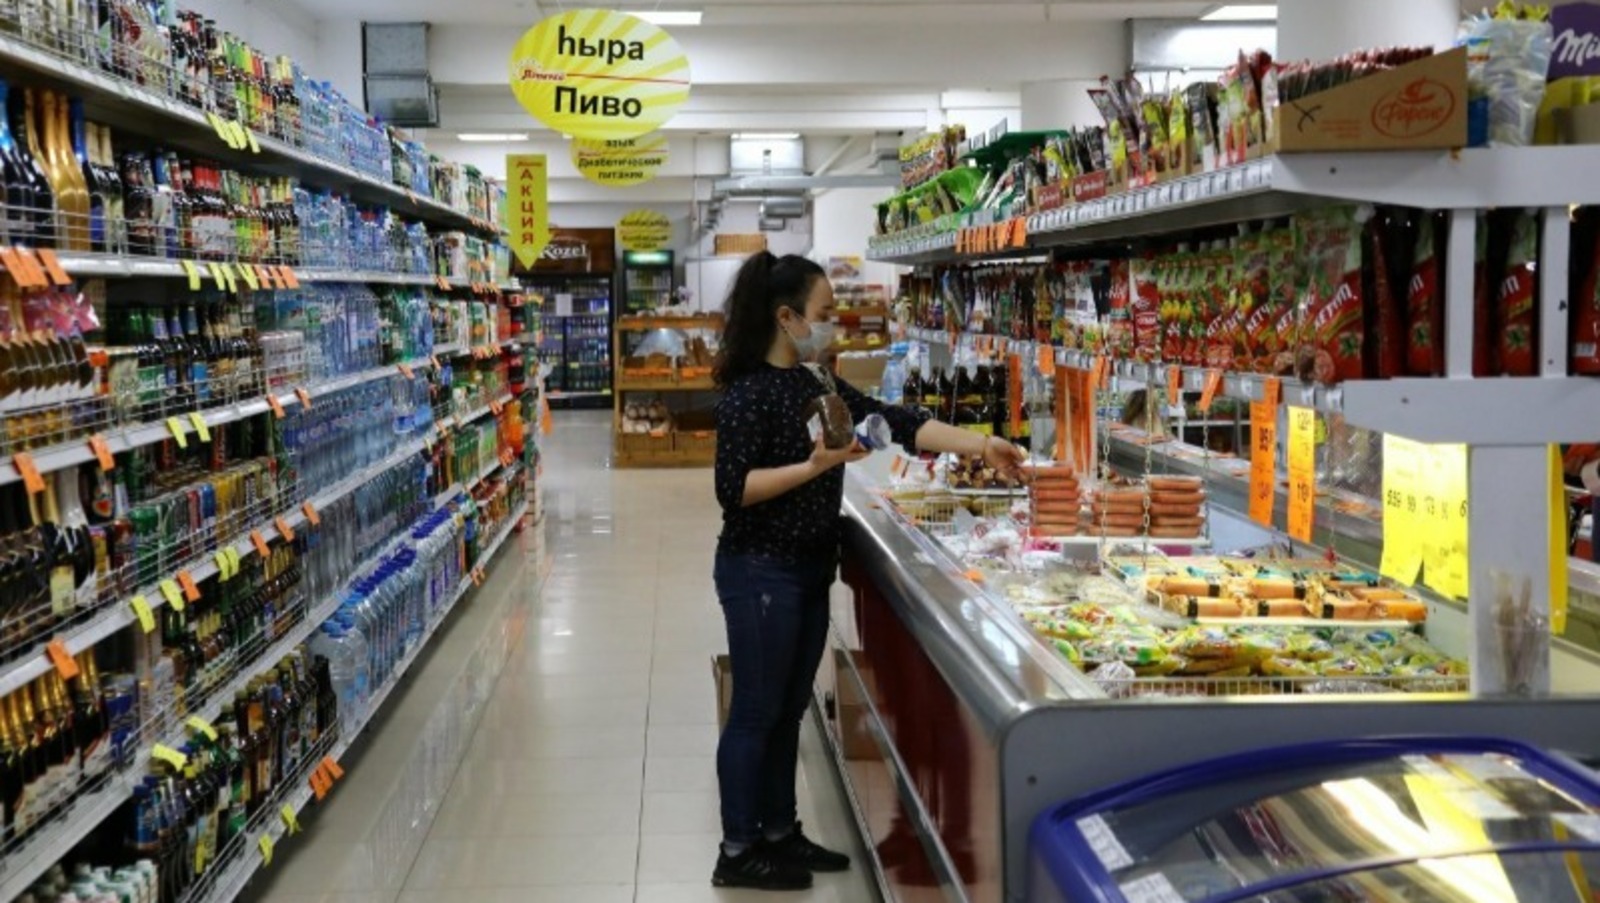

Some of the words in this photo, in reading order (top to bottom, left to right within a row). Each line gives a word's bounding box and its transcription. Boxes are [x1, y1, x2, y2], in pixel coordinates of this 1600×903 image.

[554, 85, 643, 118] Пиво
[520, 168, 535, 245] АКЦИЯ
[539, 243, 587, 260] Kozel
